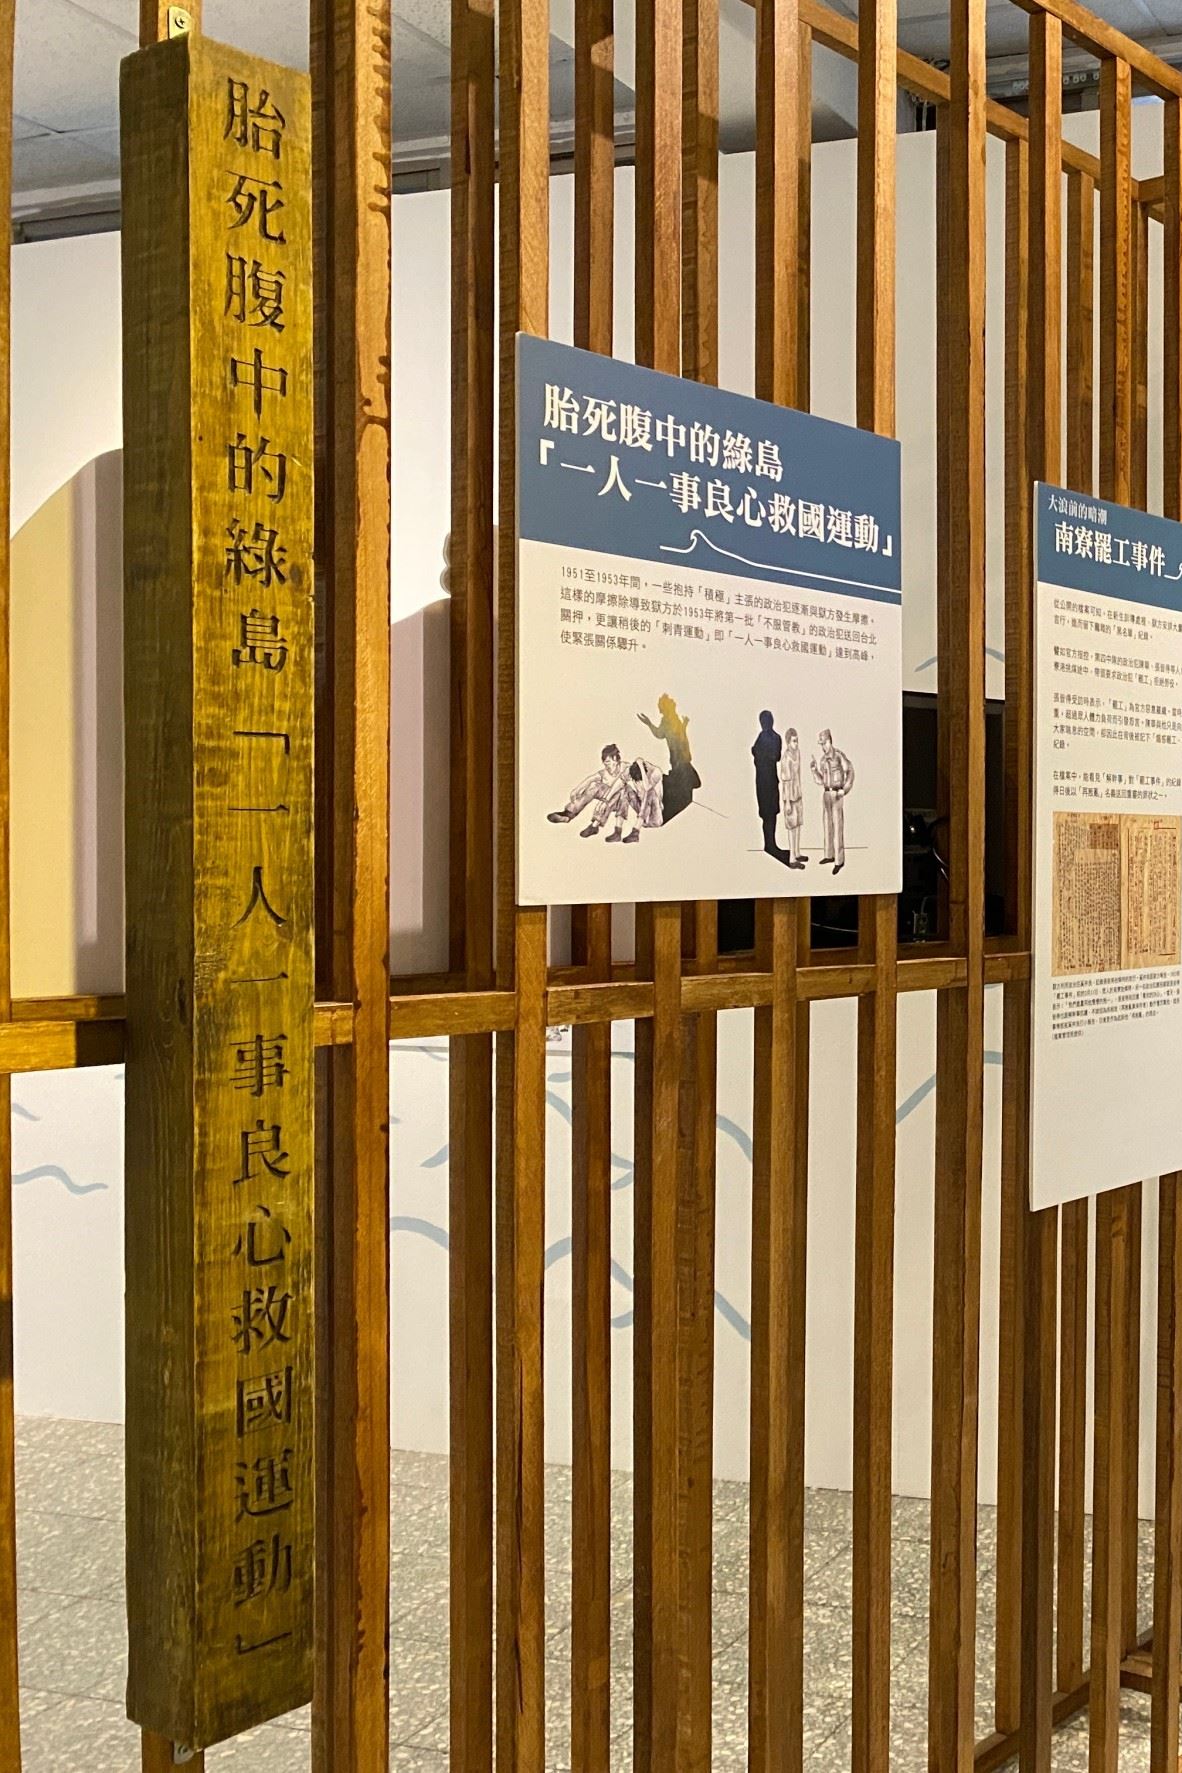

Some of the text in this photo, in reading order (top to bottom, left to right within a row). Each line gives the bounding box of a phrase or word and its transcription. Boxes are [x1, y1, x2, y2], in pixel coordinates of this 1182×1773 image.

[543, 383, 784, 482] 胎死腹中的綠島
[538, 439, 893, 557] 「一人一事良心救國運動」
[1048, 494, 1108, 526] 大浪前的暗潮
[1054, 521, 1166, 577] 南寮罷工事件
[224, 78, 293, 1655] 胎死腹中的綠島「一人一事良心救國運動」
